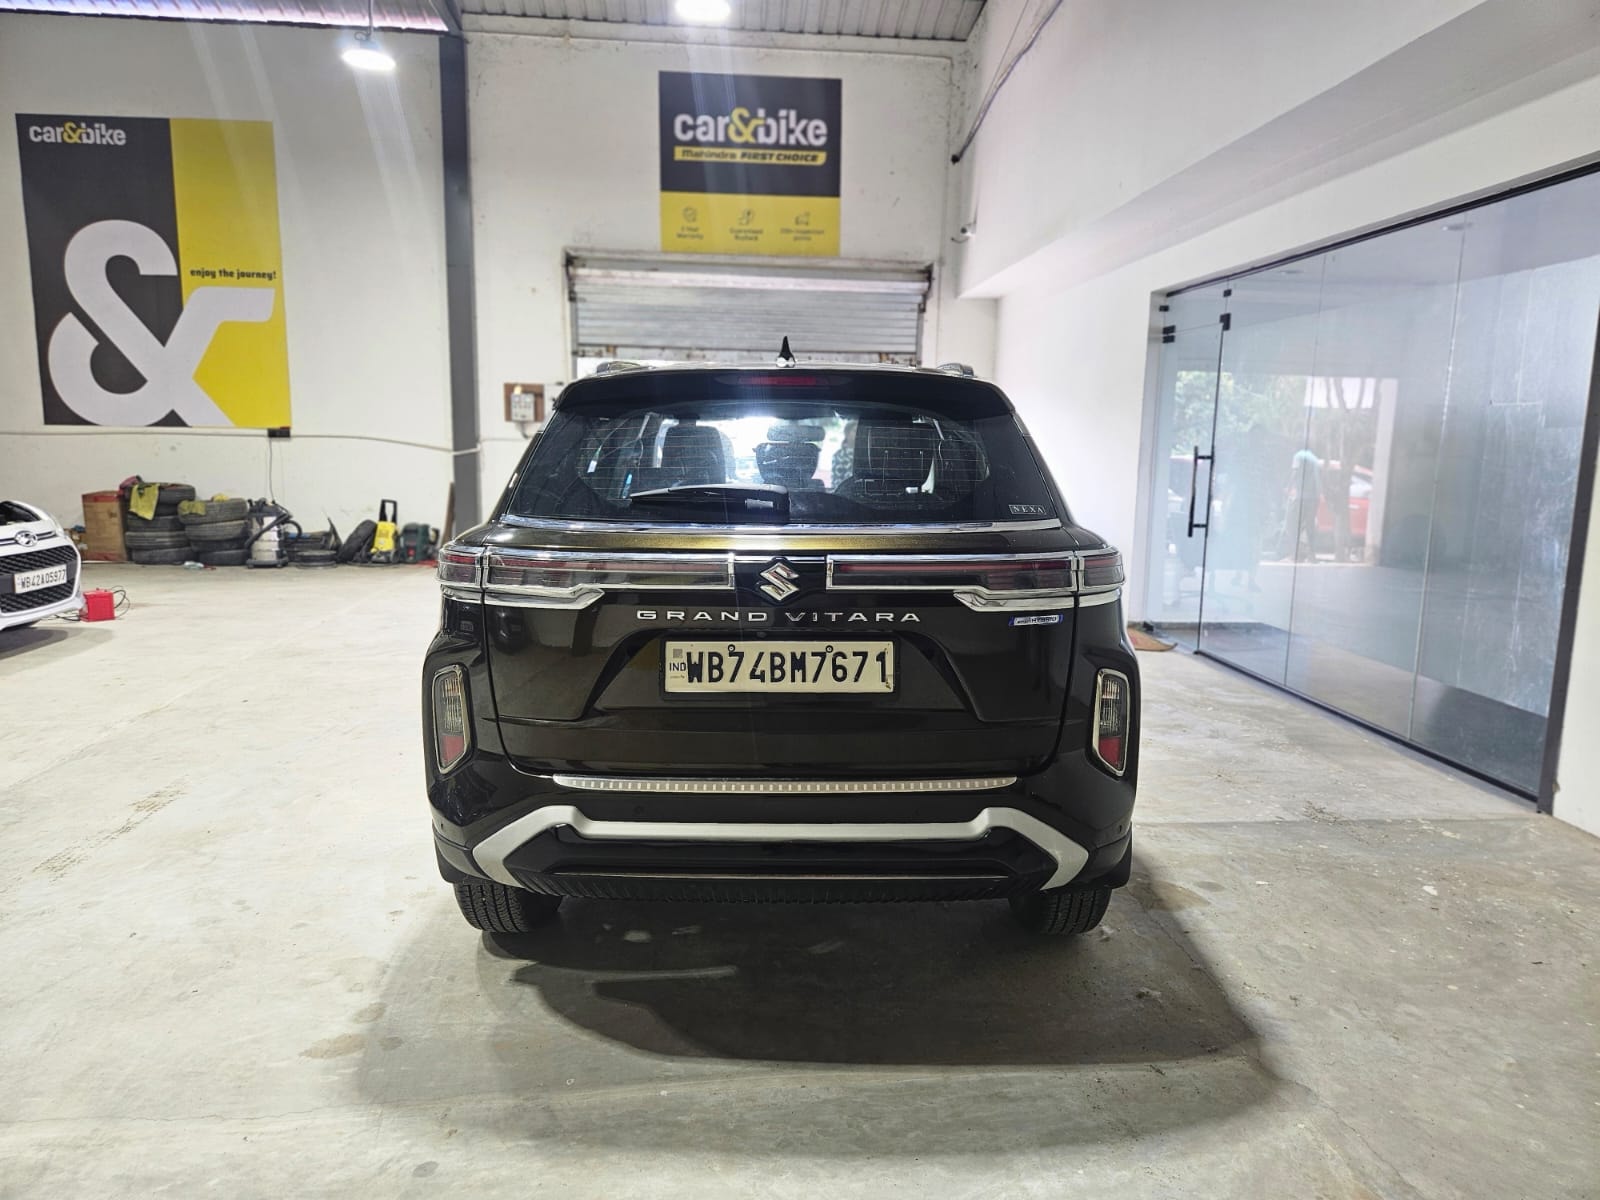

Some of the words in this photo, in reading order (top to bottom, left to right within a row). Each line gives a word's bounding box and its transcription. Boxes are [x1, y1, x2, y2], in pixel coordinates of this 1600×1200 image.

[29, 122, 126, 145] car&bike
[674, 107, 828, 146] car&bike
[740, 151, 773, 161] FIRST
[775, 153, 819, 163] CHOICE
[190, 267, 216, 279] enjoy
[219, 268, 234, 278] the
[237, 269, 276, 281] journey!
[636, 610, 768, 622] GRAND
[785, 612, 921, 622] VITARA
[669, 662, 687, 672] IND
[686, 650, 887, 683] WB74BM7671
